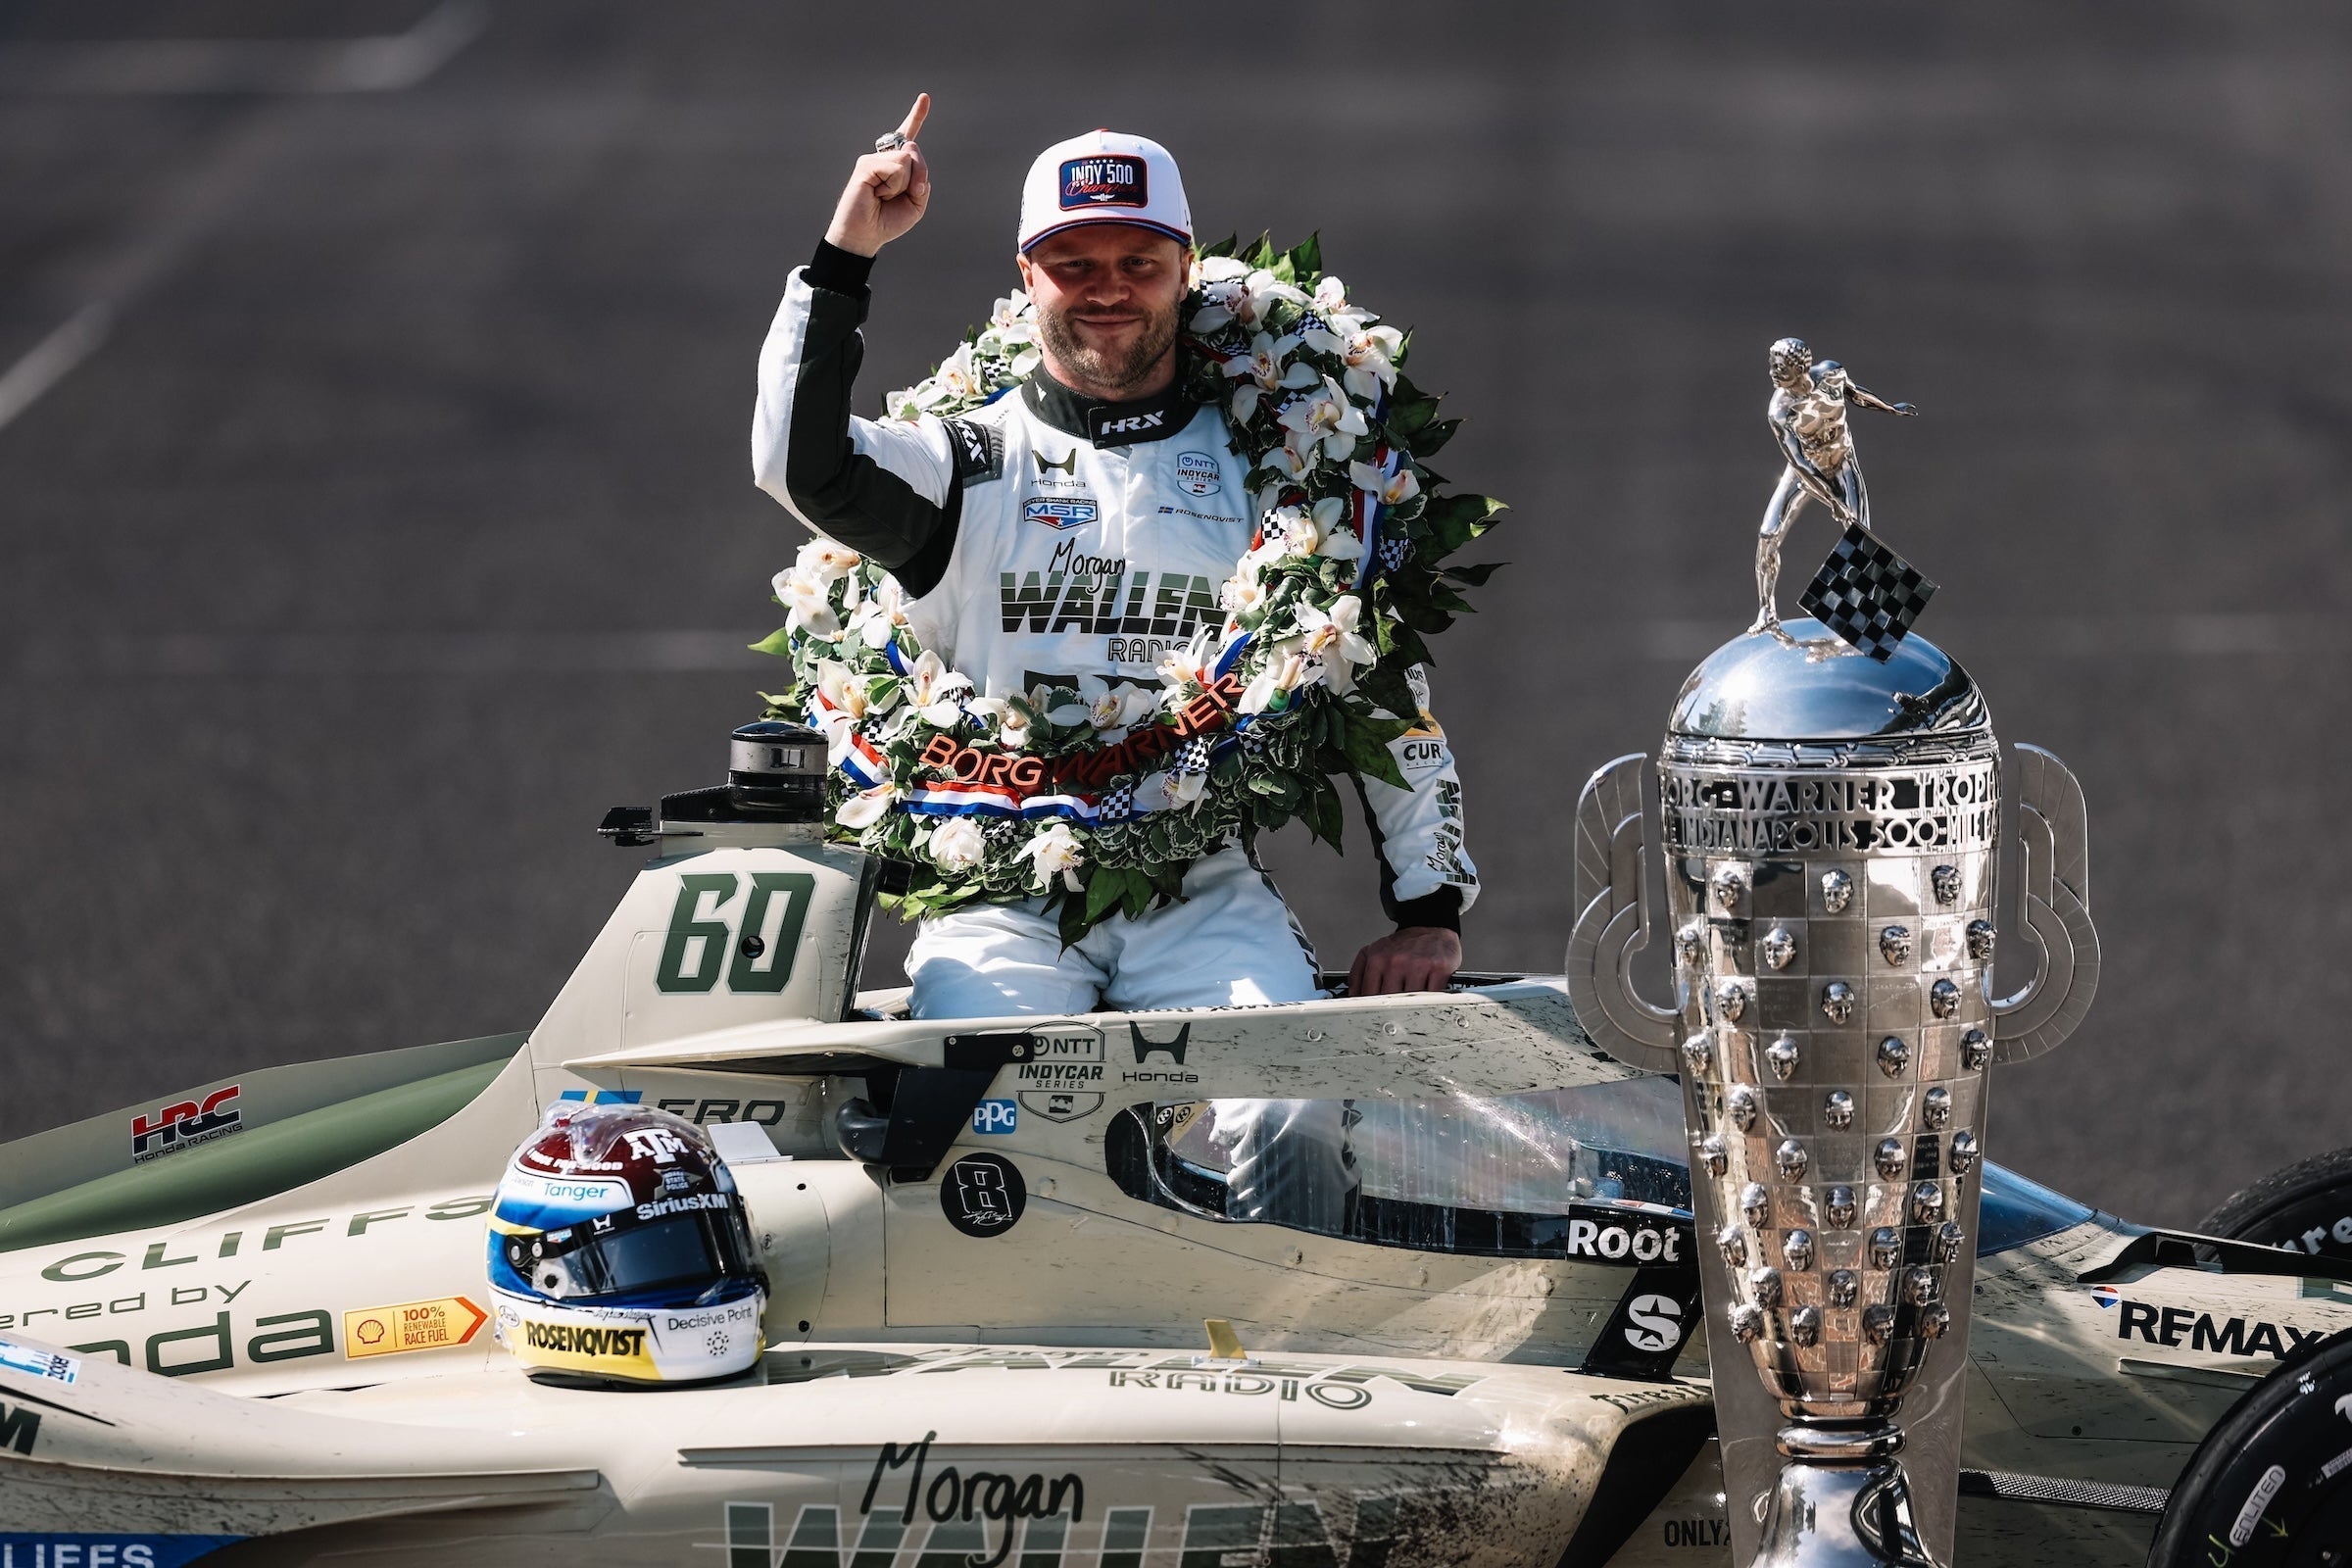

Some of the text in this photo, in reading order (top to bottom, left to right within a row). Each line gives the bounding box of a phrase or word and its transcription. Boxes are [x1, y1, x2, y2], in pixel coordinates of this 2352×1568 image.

[1071, 164, 1133, 186] INDY 500
[1101, 410, 1165, 435] HRX
[1177, 468, 1220, 481] INDYCAR
[1195, 459, 1215, 469] NTT
[1031, 478, 1086, 487] Honda
[1026, 505, 1094, 517] MSR
[1176, 509, 1244, 523] ROSENQVIST
[1049, 538, 1126, 595] Morgan
[1000, 570, 1227, 642] WALLEN
[1403, 743, 1445, 761] CUR
[654, 871, 818, 997] 60
[1054, 1038, 1096, 1054] NTT
[1019, 1065, 1103, 1079] INDYCAR
[1035, 1080, 1085, 1089] SERIES
[1122, 1071, 1199, 1083] Honda
[131, 1084, 241, 1156] HRC
[973, 1102, 1015, 1132] PPG
[134, 1123, 243, 1164] Honda RACING
[544, 1182, 609, 1201] Tanger
[666, 1182, 689, 1191] POLICE
[955, 1161, 1012, 1218] 8
[636, 1193, 728, 1221] SiriusXM
[41, 1195, 492, 1283] CLIFFS
[1567, 1219, 1680, 1263] Root
[172, 1280, 252, 1305] by
[403, 1305, 446, 1322] 100%
[404, 1318, 446, 1333] RENEWABLE
[668, 1313, 725, 1331] Decisive
[727, 1305, 753, 1322] Point
[405, 1328, 450, 1346] RACE FUEL
[525, 1321, 646, 1357] ROSENQVIST
[2118, 1299, 2326, 1361] REMAX
[1109, 1370, 1372, 1410] RADIO
[861, 1431, 1084, 1568] Morgan
[1665, 1519, 1731, 1547] ONLY
